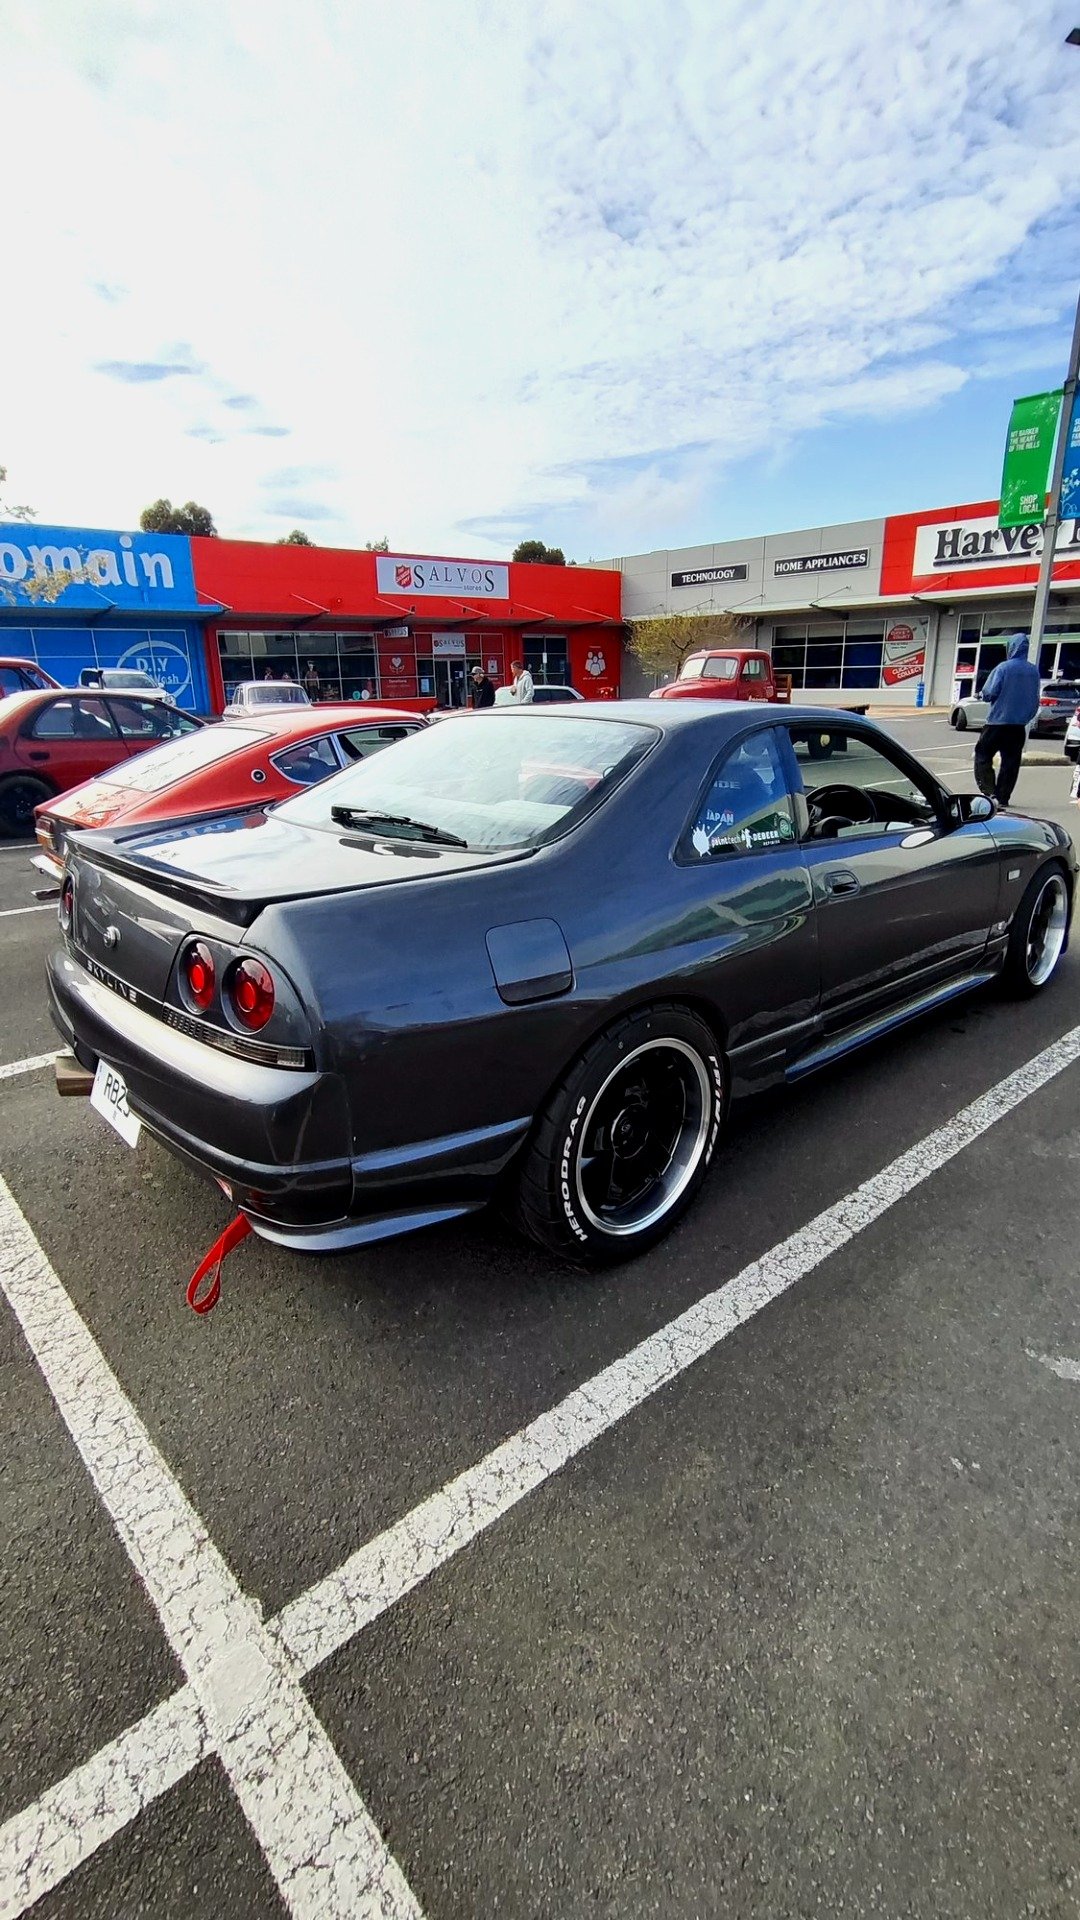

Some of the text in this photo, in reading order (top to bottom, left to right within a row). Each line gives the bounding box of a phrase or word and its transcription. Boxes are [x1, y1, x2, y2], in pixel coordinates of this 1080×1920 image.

[1020, 494, 1038, 505] SHOP
[1019, 503, 1041, 514] LOCAL
[776, 553, 866, 573] HOME APPLIANCES
[413, 565, 495, 592] SALVOS
[681, 568, 735, 584] TECHNOLOGY
[706, 808, 734, 824] JAPAN
[87, 959, 137, 1003] SKYLINE
